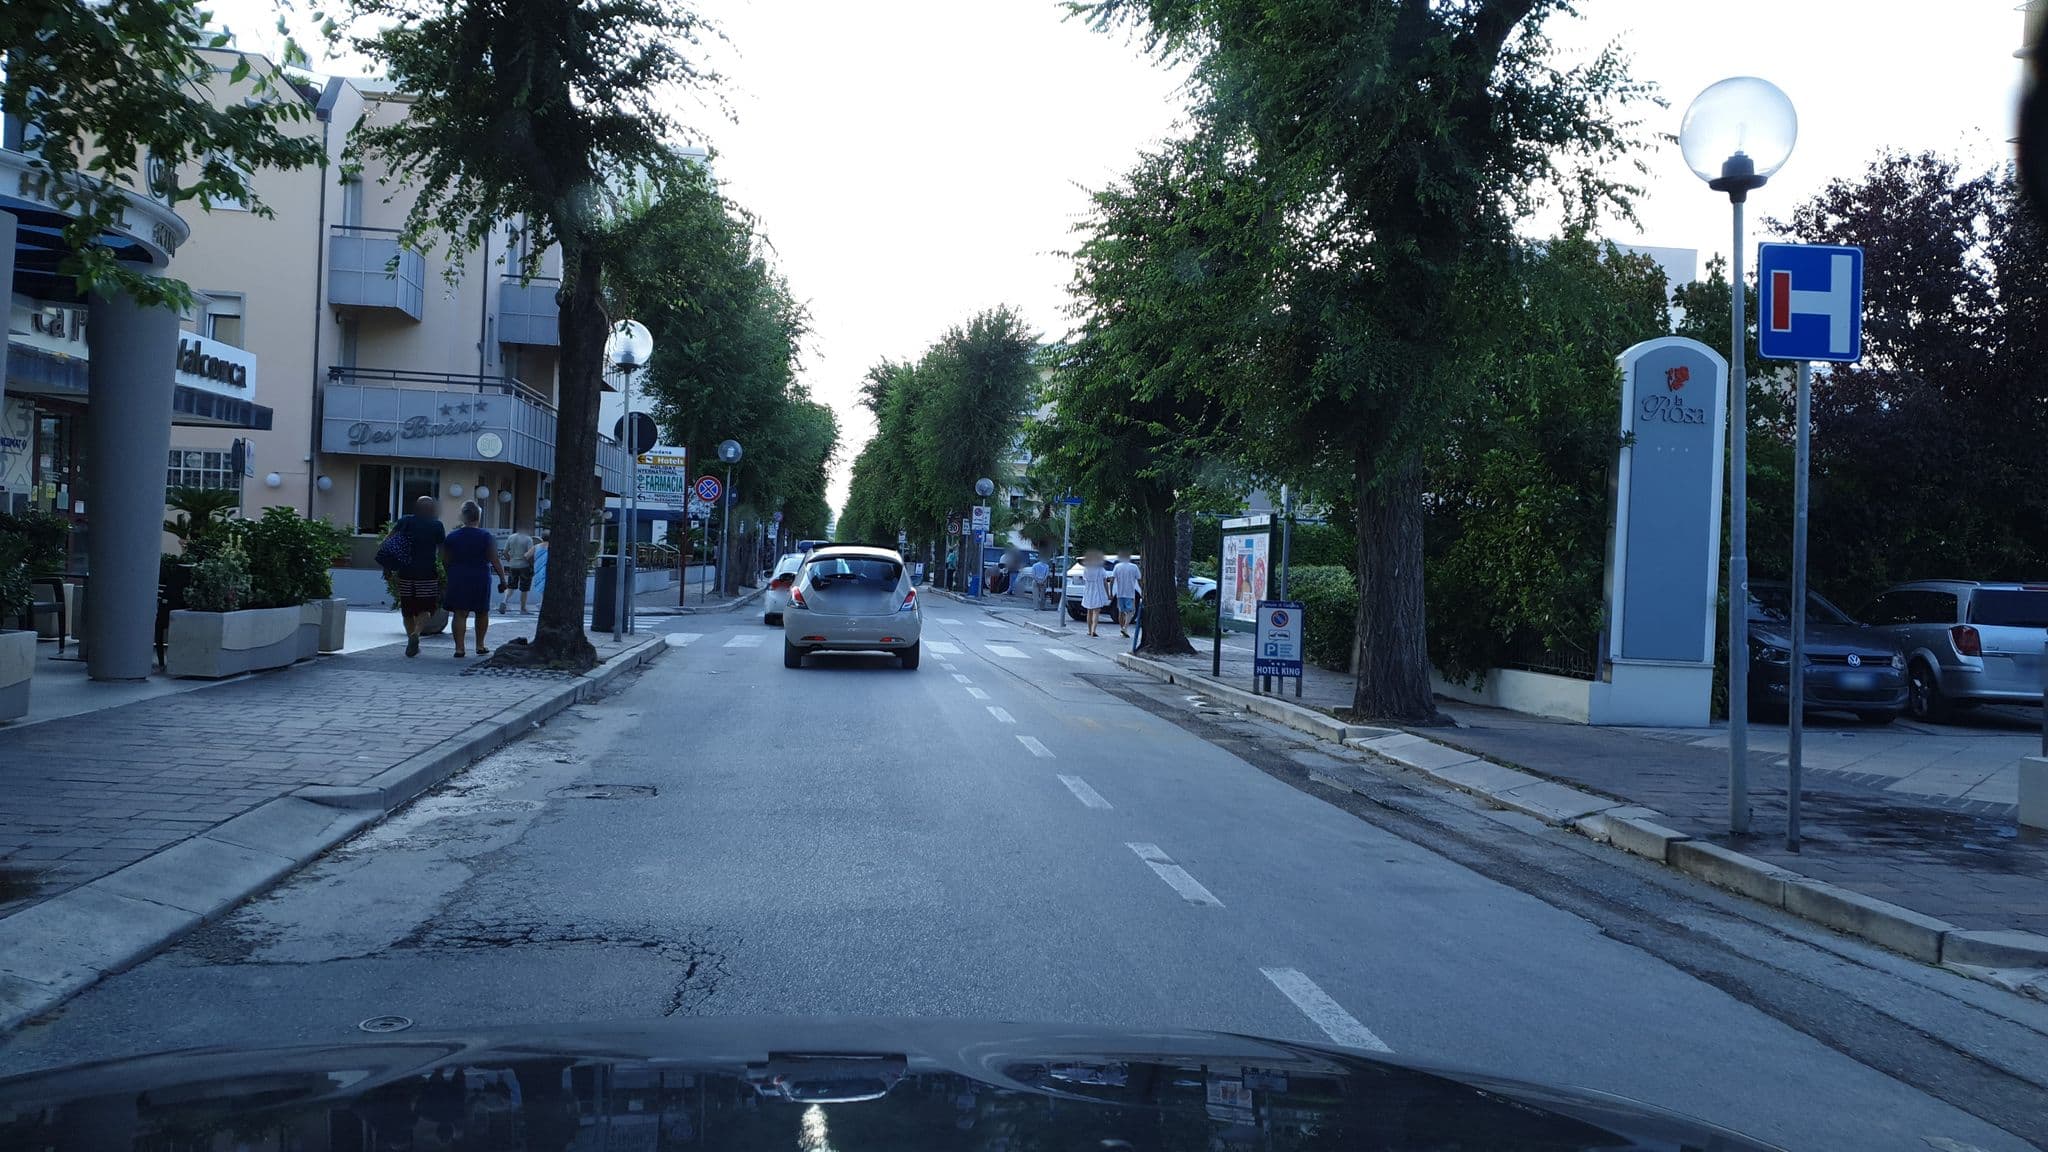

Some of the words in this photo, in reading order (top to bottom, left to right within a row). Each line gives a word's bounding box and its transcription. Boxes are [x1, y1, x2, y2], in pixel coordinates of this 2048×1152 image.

[1641, 394, 1705, 424] Rosa
[348, 421, 396, 446] Des
[400, 415, 487, 439] Bains
[657, 457, 685, 465] Hotels
[646, 475, 683, 492] FARMACIA
[1267, 644, 1276, 655] P
[1256, 665, 1279, 675] HOTEL
[1281, 667, 1301, 676] KING
